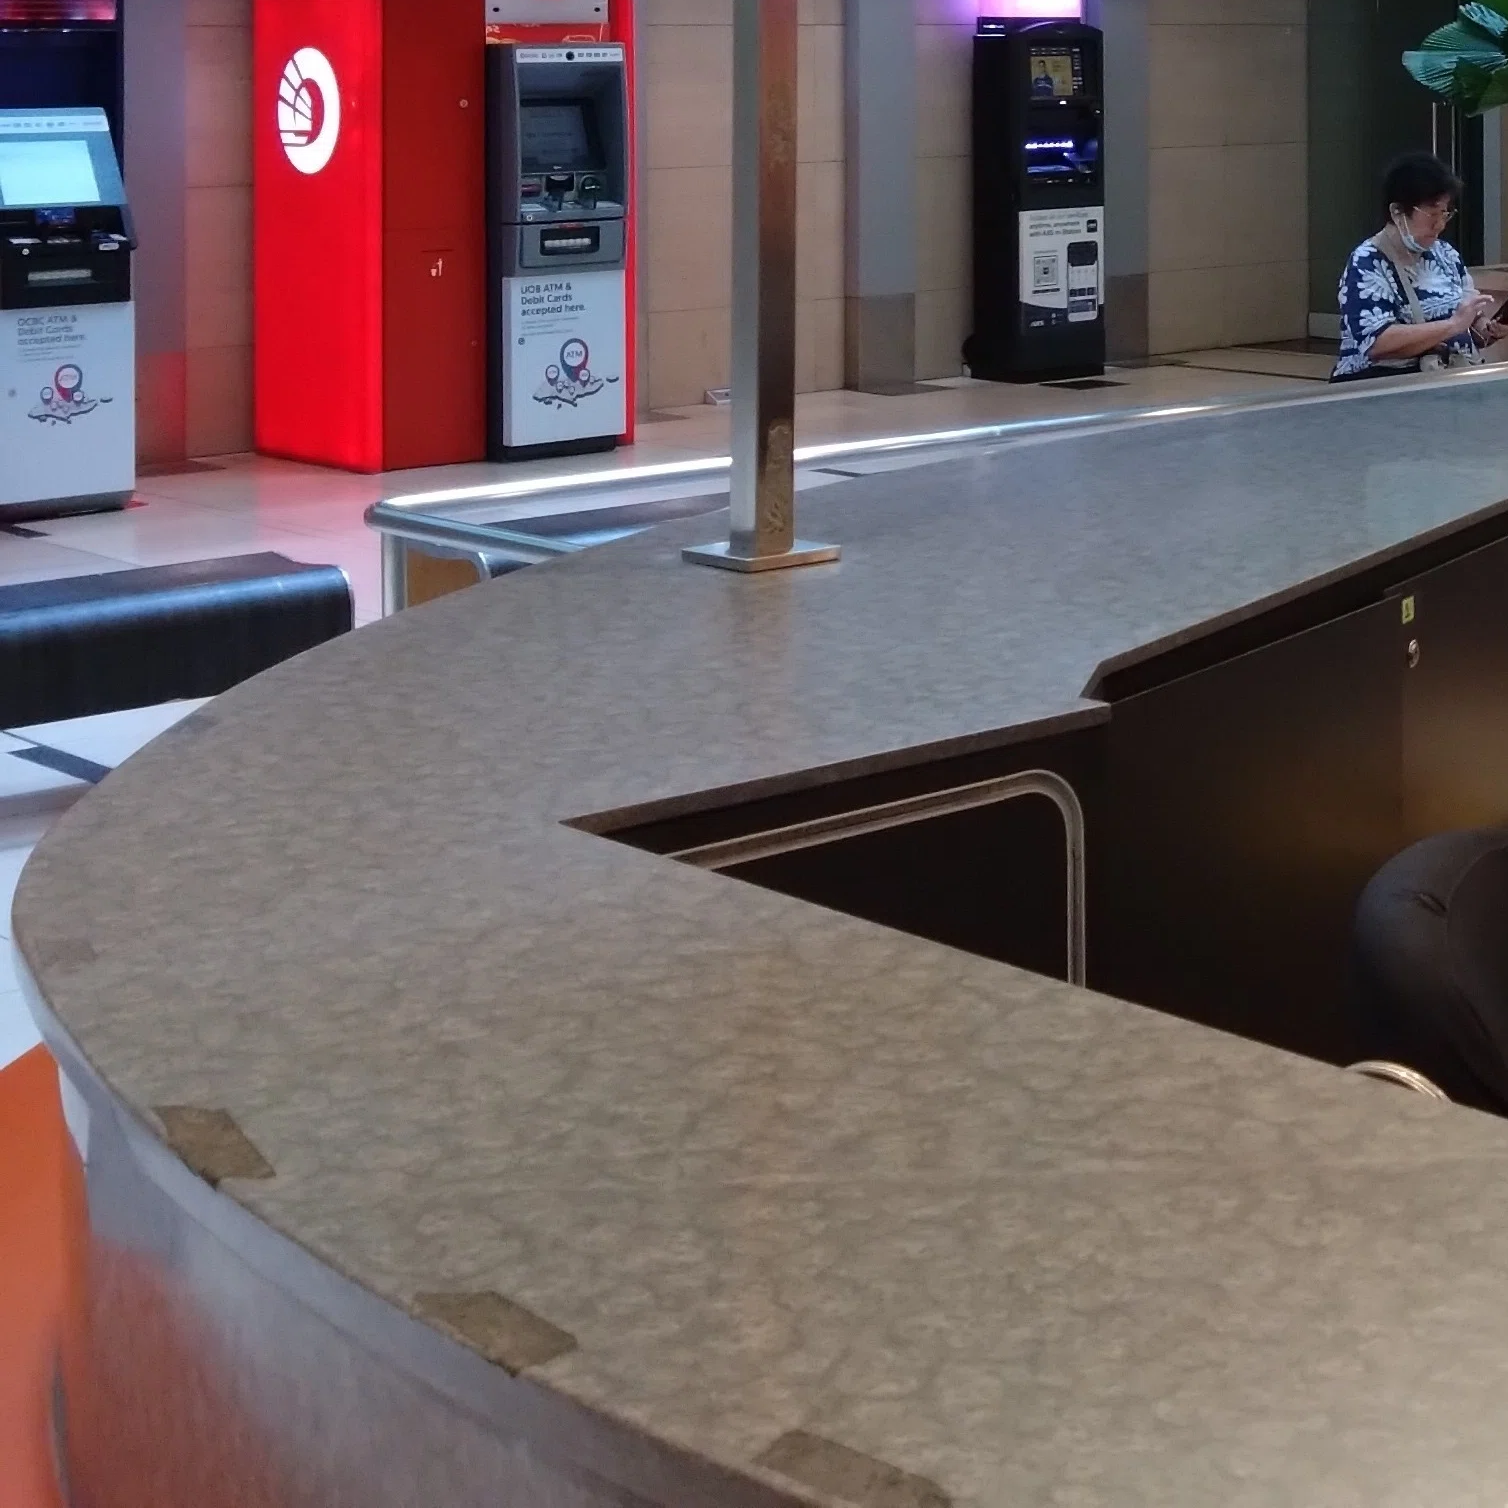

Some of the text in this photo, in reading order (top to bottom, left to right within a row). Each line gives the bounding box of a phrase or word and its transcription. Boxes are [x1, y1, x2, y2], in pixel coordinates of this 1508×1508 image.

[521, 284, 541, 295] UOB
[543, 283, 563, 292] ATM
[521, 293, 573, 305] Debit Cards
[521, 305, 562, 316] accepted
